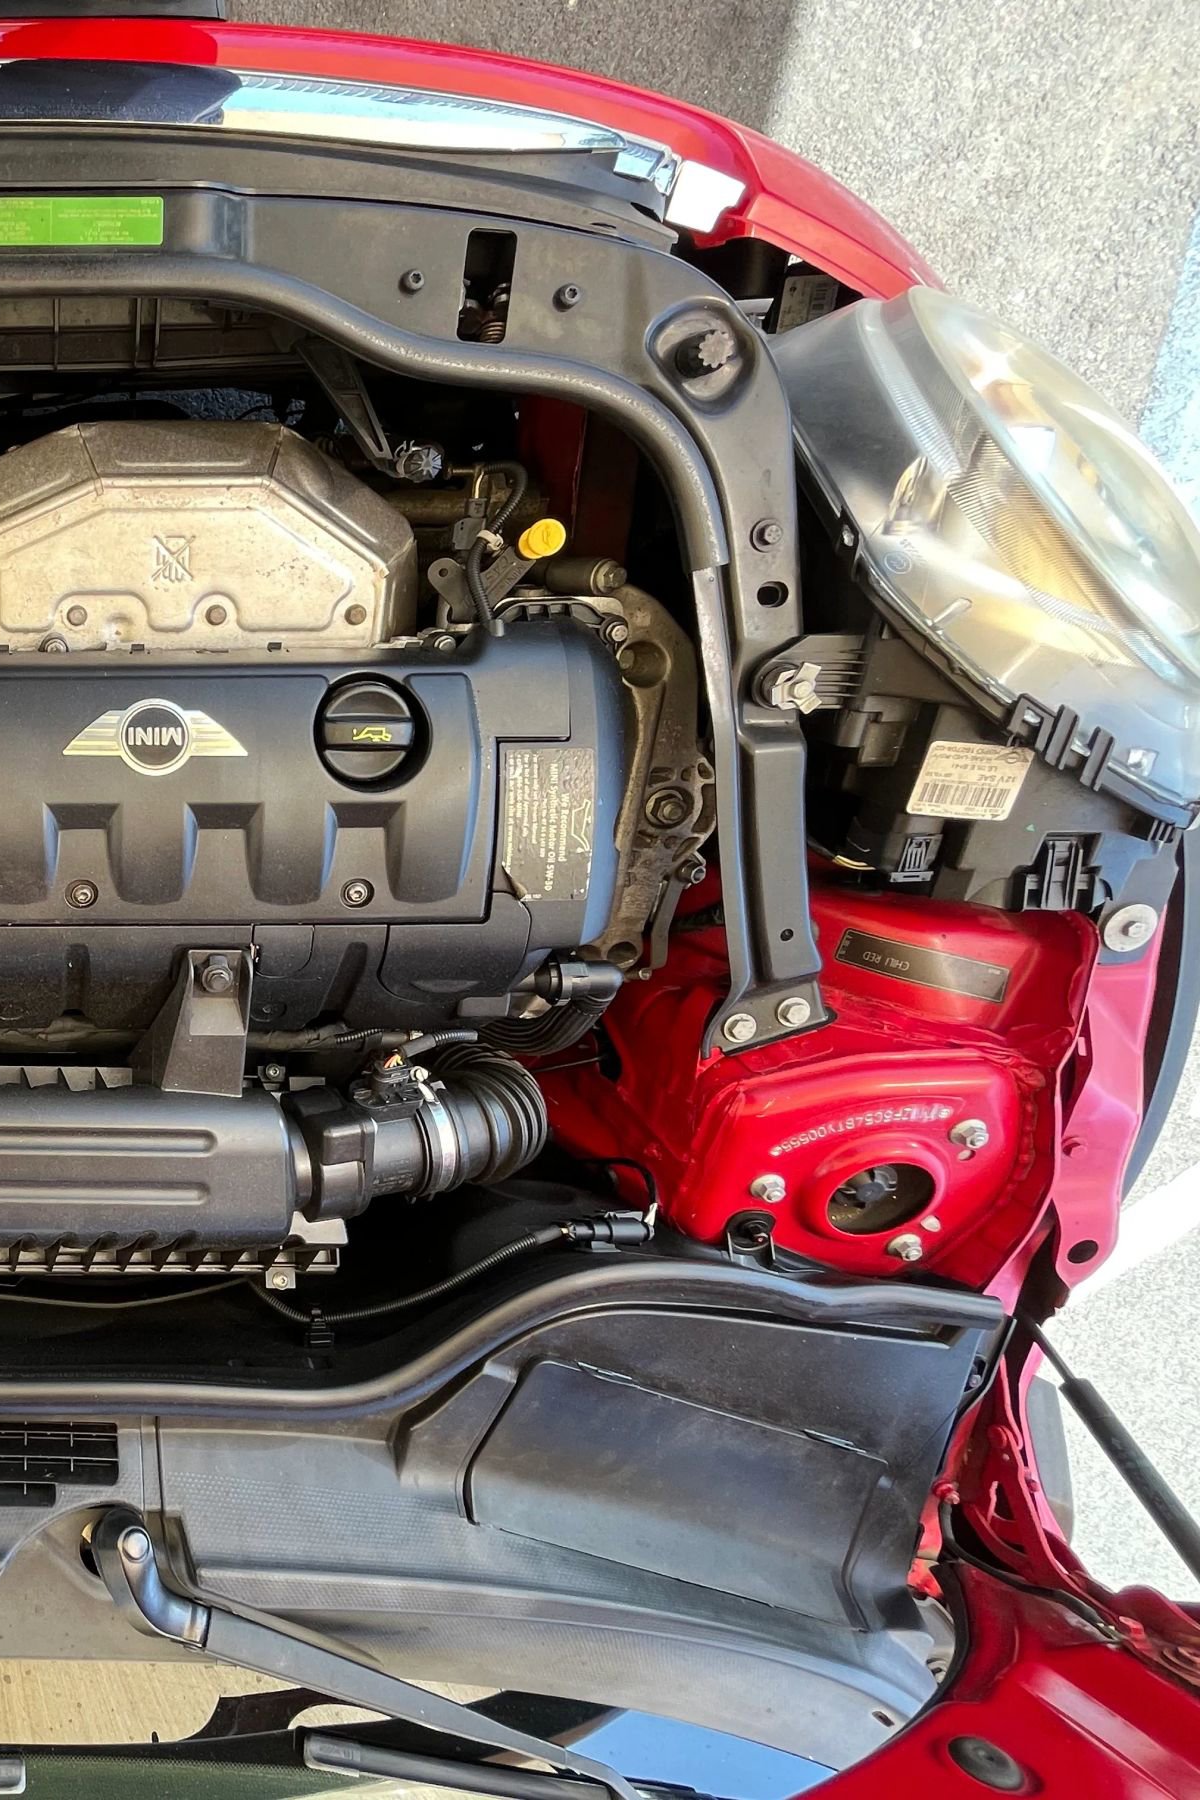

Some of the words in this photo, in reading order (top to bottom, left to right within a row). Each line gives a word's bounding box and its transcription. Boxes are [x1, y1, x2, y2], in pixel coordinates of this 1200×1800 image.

[128, 726, 182, 746] MINI
[550, 763, 558, 784] MINI
[548, 786, 558, 823] Synthetic
[561, 793, 569, 807] We
[548, 825, 558, 850] Motor
[558, 809, 569, 862] Recommend
[547, 851, 555, 863] Oil
[544, 864, 553, 891] 5W-30
[862, 951, 882, 967] RED
[884, 956, 910, 971] CHILI
